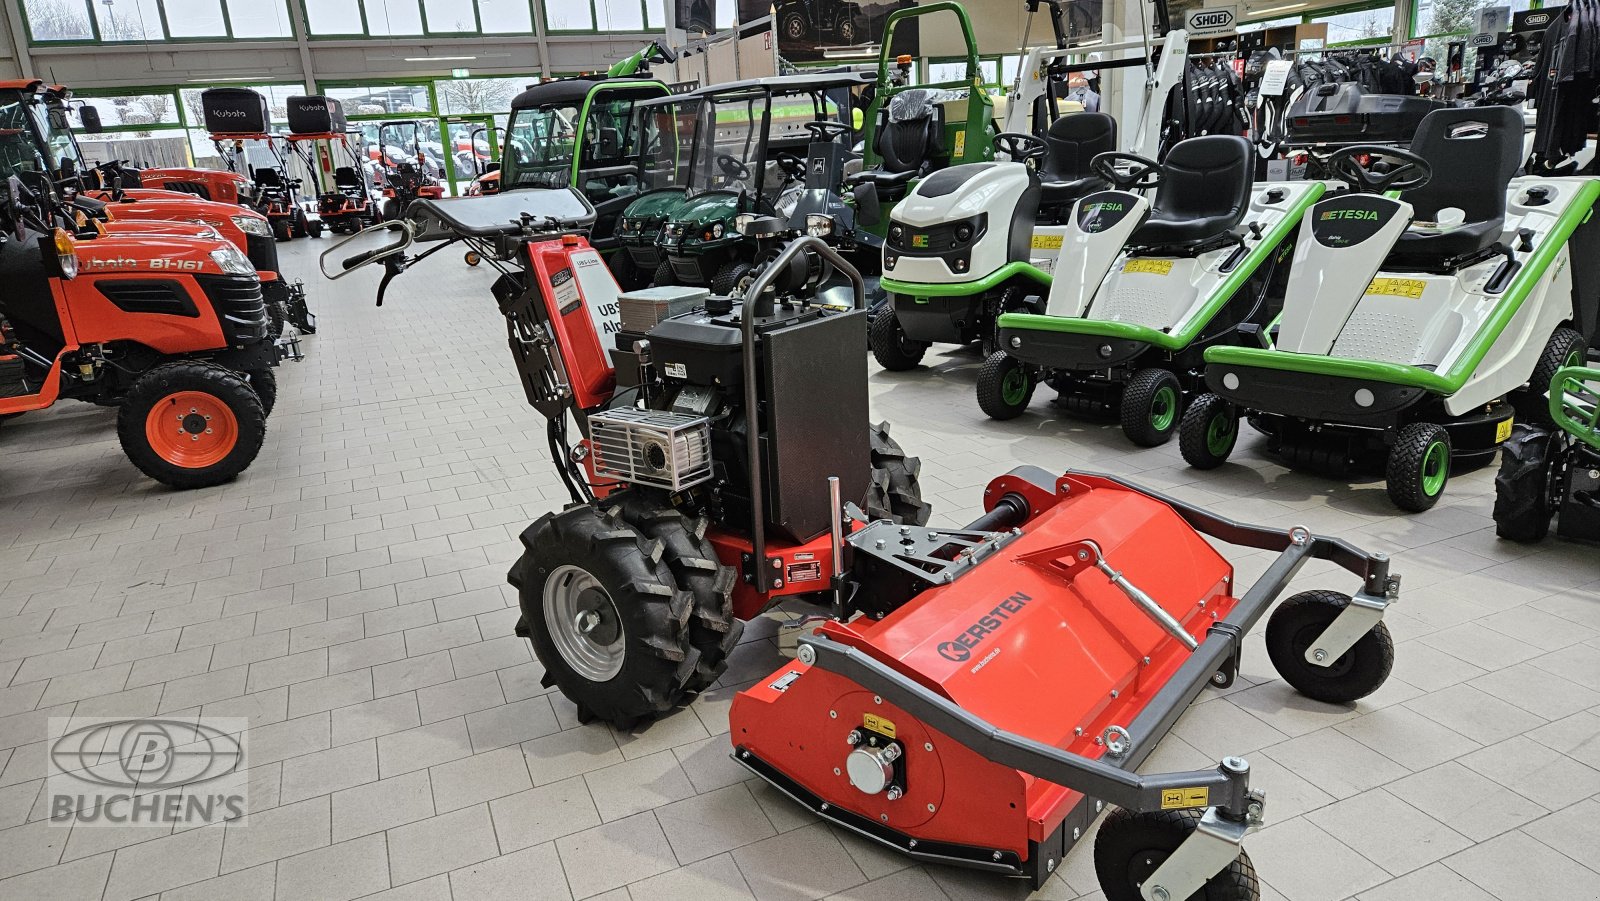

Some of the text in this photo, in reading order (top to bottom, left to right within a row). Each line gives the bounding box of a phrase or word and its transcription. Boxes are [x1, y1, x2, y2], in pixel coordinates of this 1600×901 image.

[1196, 13, 1227, 26] SHOEI
[1528, 15, 1547, 24] SHOEI
[213, 109, 246, 118] Kubota
[299, 104, 325, 112] Kubota
[1090, 202, 1123, 212] ETESIA
[1329, 209, 1378, 221] ETESIA
[85, 255, 203, 271] ubota B1-161
[937, 591, 1033, 662] KERSTEN
